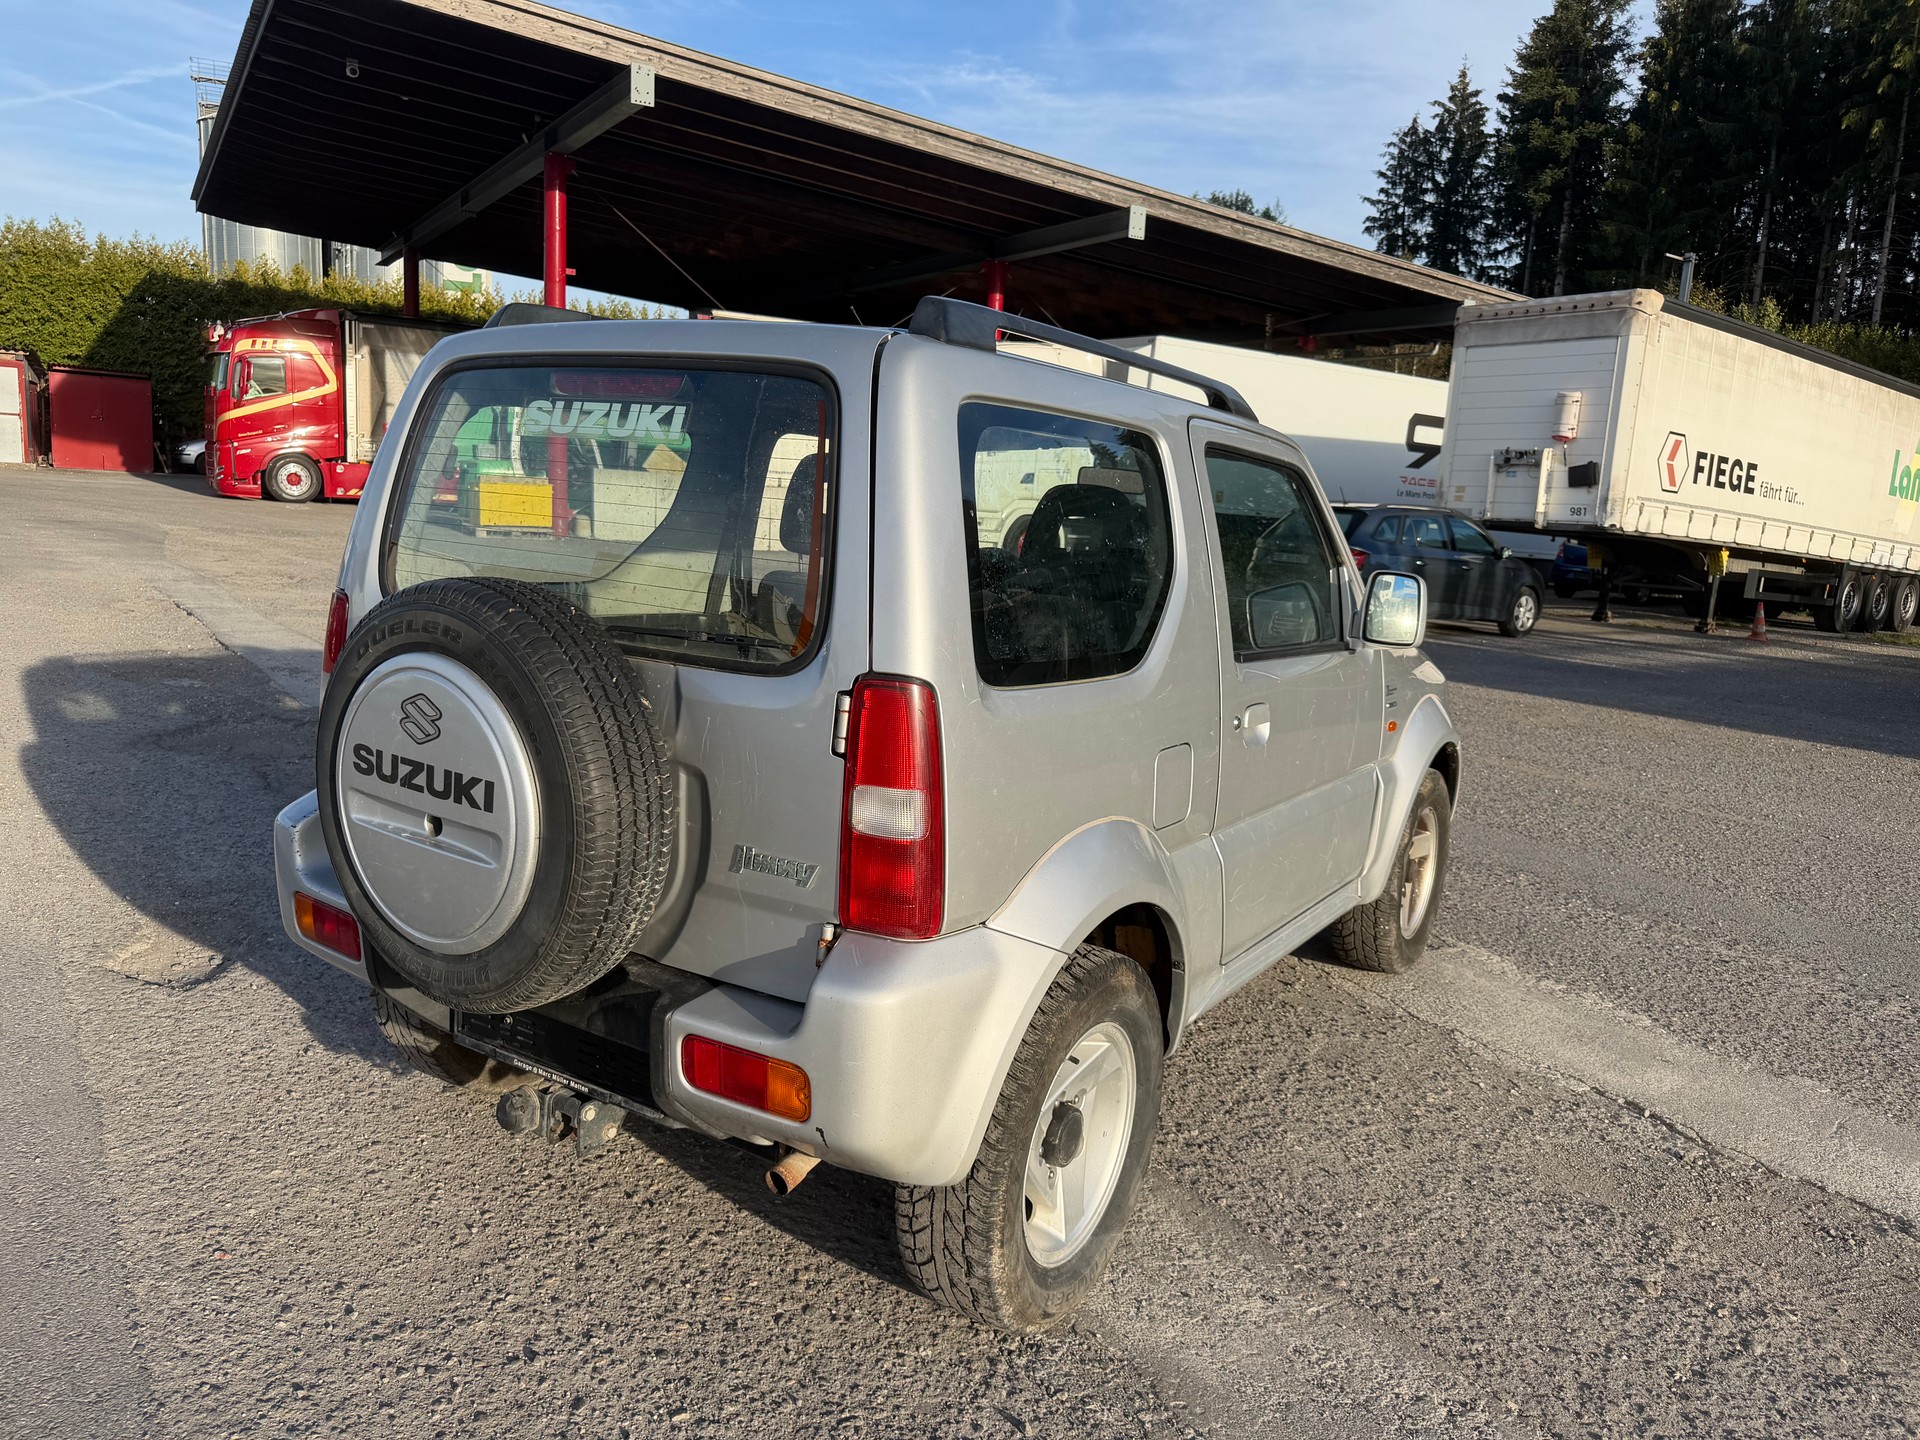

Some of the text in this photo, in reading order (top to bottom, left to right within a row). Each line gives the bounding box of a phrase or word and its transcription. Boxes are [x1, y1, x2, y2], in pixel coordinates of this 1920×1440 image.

[522, 398, 688, 441] SUZUKI
[1396, 489, 1404, 497] Le
[1405, 490, 1421, 499] Mans
[1692, 450, 1805, 506] FIEGE fährt für...
[1569, 506, 1588, 517] 981
[356, 618, 465, 663] DUELER
[351, 743, 495, 815] SUZUKI
[513, 1058, 590, 1093] Garage Marc Müller Matten
